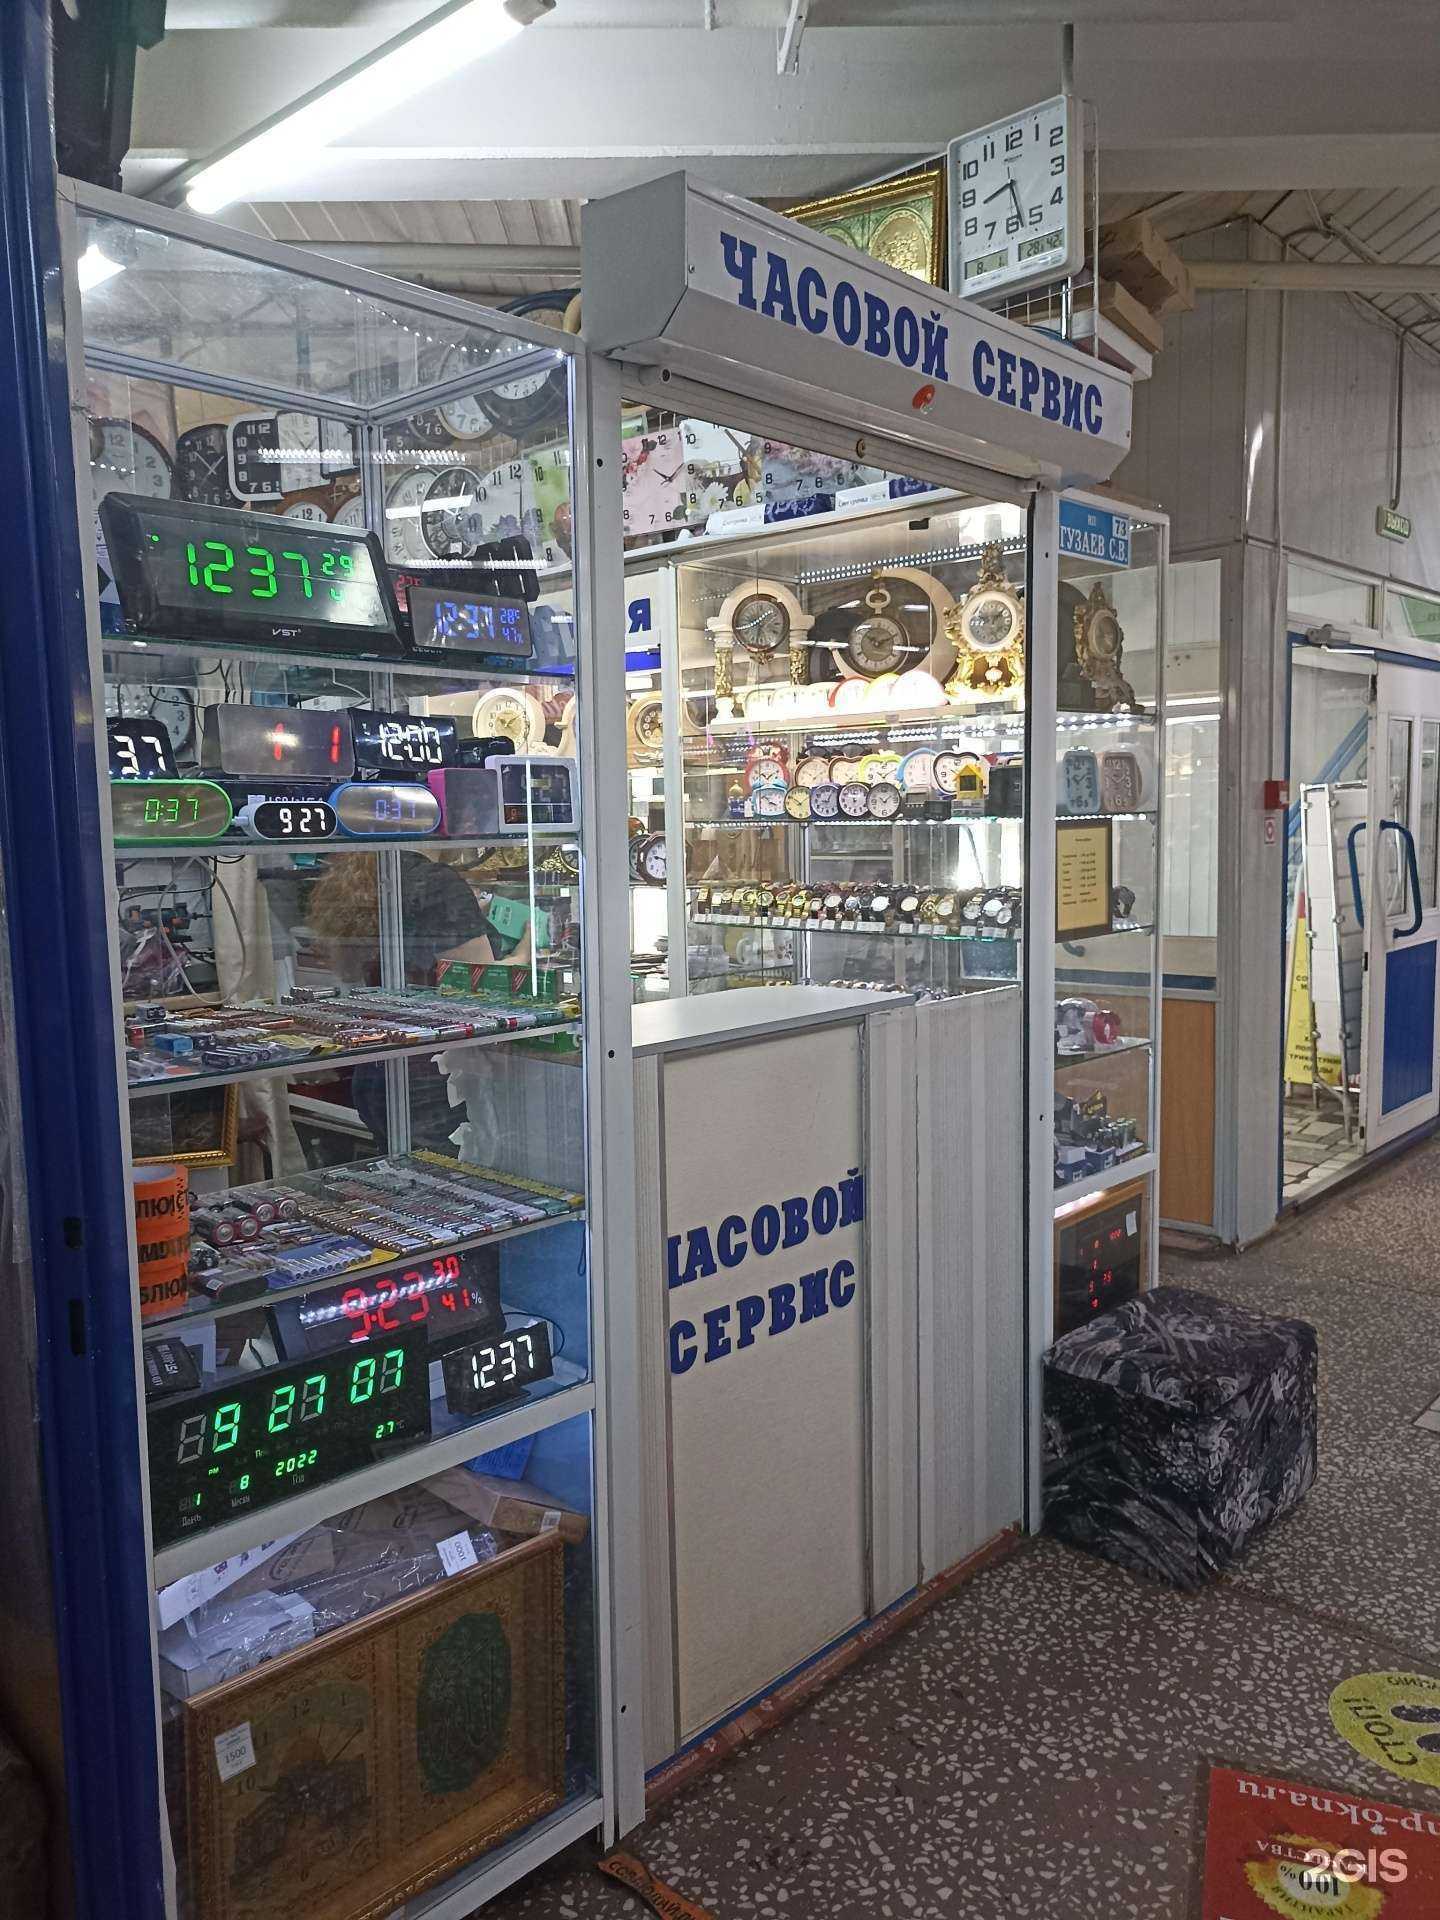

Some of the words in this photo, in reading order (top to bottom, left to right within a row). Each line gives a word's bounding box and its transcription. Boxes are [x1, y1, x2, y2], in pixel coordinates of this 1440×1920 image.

[1005, 130, 1023, 152] 12
[1050, 126, 1063, 147] 2
[983, 142, 995, 161] 11
[962, 160, 978, 180] 10
[1050, 155, 1064, 176] 3
[962, 189, 976, 208] 9
[1050, 187, 1063, 205] 4
[1029, 205, 1043, 225] 5
[965, 217, 977, 236] 8
[984, 221, 997, 240] 7
[1006, 214, 1020, 234] 6
[720, 231, 949, 383] ЧАСОВОЙ
[973, 340, 1103, 435] СЕРВИС
[247, 425, 257, 436] 11
[258, 423, 271, 434] 12
[237, 437, 247, 447] 10
[657, 434, 668, 446] 12
[685, 433, 697, 445] 10
[764, 441, 773, 454] 9
[238, 454, 247, 465] 9
[509, 463, 522, 480] 12
[534, 466, 544, 482] 10
[687, 463, 696, 475] 9
[239, 471, 248, 482] 8
[492, 471, 503, 486] 11
[765, 472, 774, 485] 8
[815, 476, 824, 489] 6
[249, 482, 259, 493] 7
[262, 481, 272, 492] 6
[796, 479, 804, 492] 7
[474, 486, 488, 502] 10
[689, 493, 698, 505] 8
[755, 492, 763, 503] 5
[718, 497, 727, 510] 7
[735, 495, 744, 507] 6
[302, 508, 314, 521] 12
[623, 509, 631, 520] 8
[648, 514, 656, 525] 7
[664, 511, 673, 523] 6
[1060, 525, 1106, 556] ГУЗАЕВ
[1109, 538, 1129, 563] С.В.
[321, 552, 354, 578] 29
[271, 628, 302, 638] VST
[670, 1260, 856, 1375] СЕРВИС
[274, 1449, 318, 1477] 2022
[238, 1474, 250, 1491] 8
[224, 1745, 247, 1764] 1500
